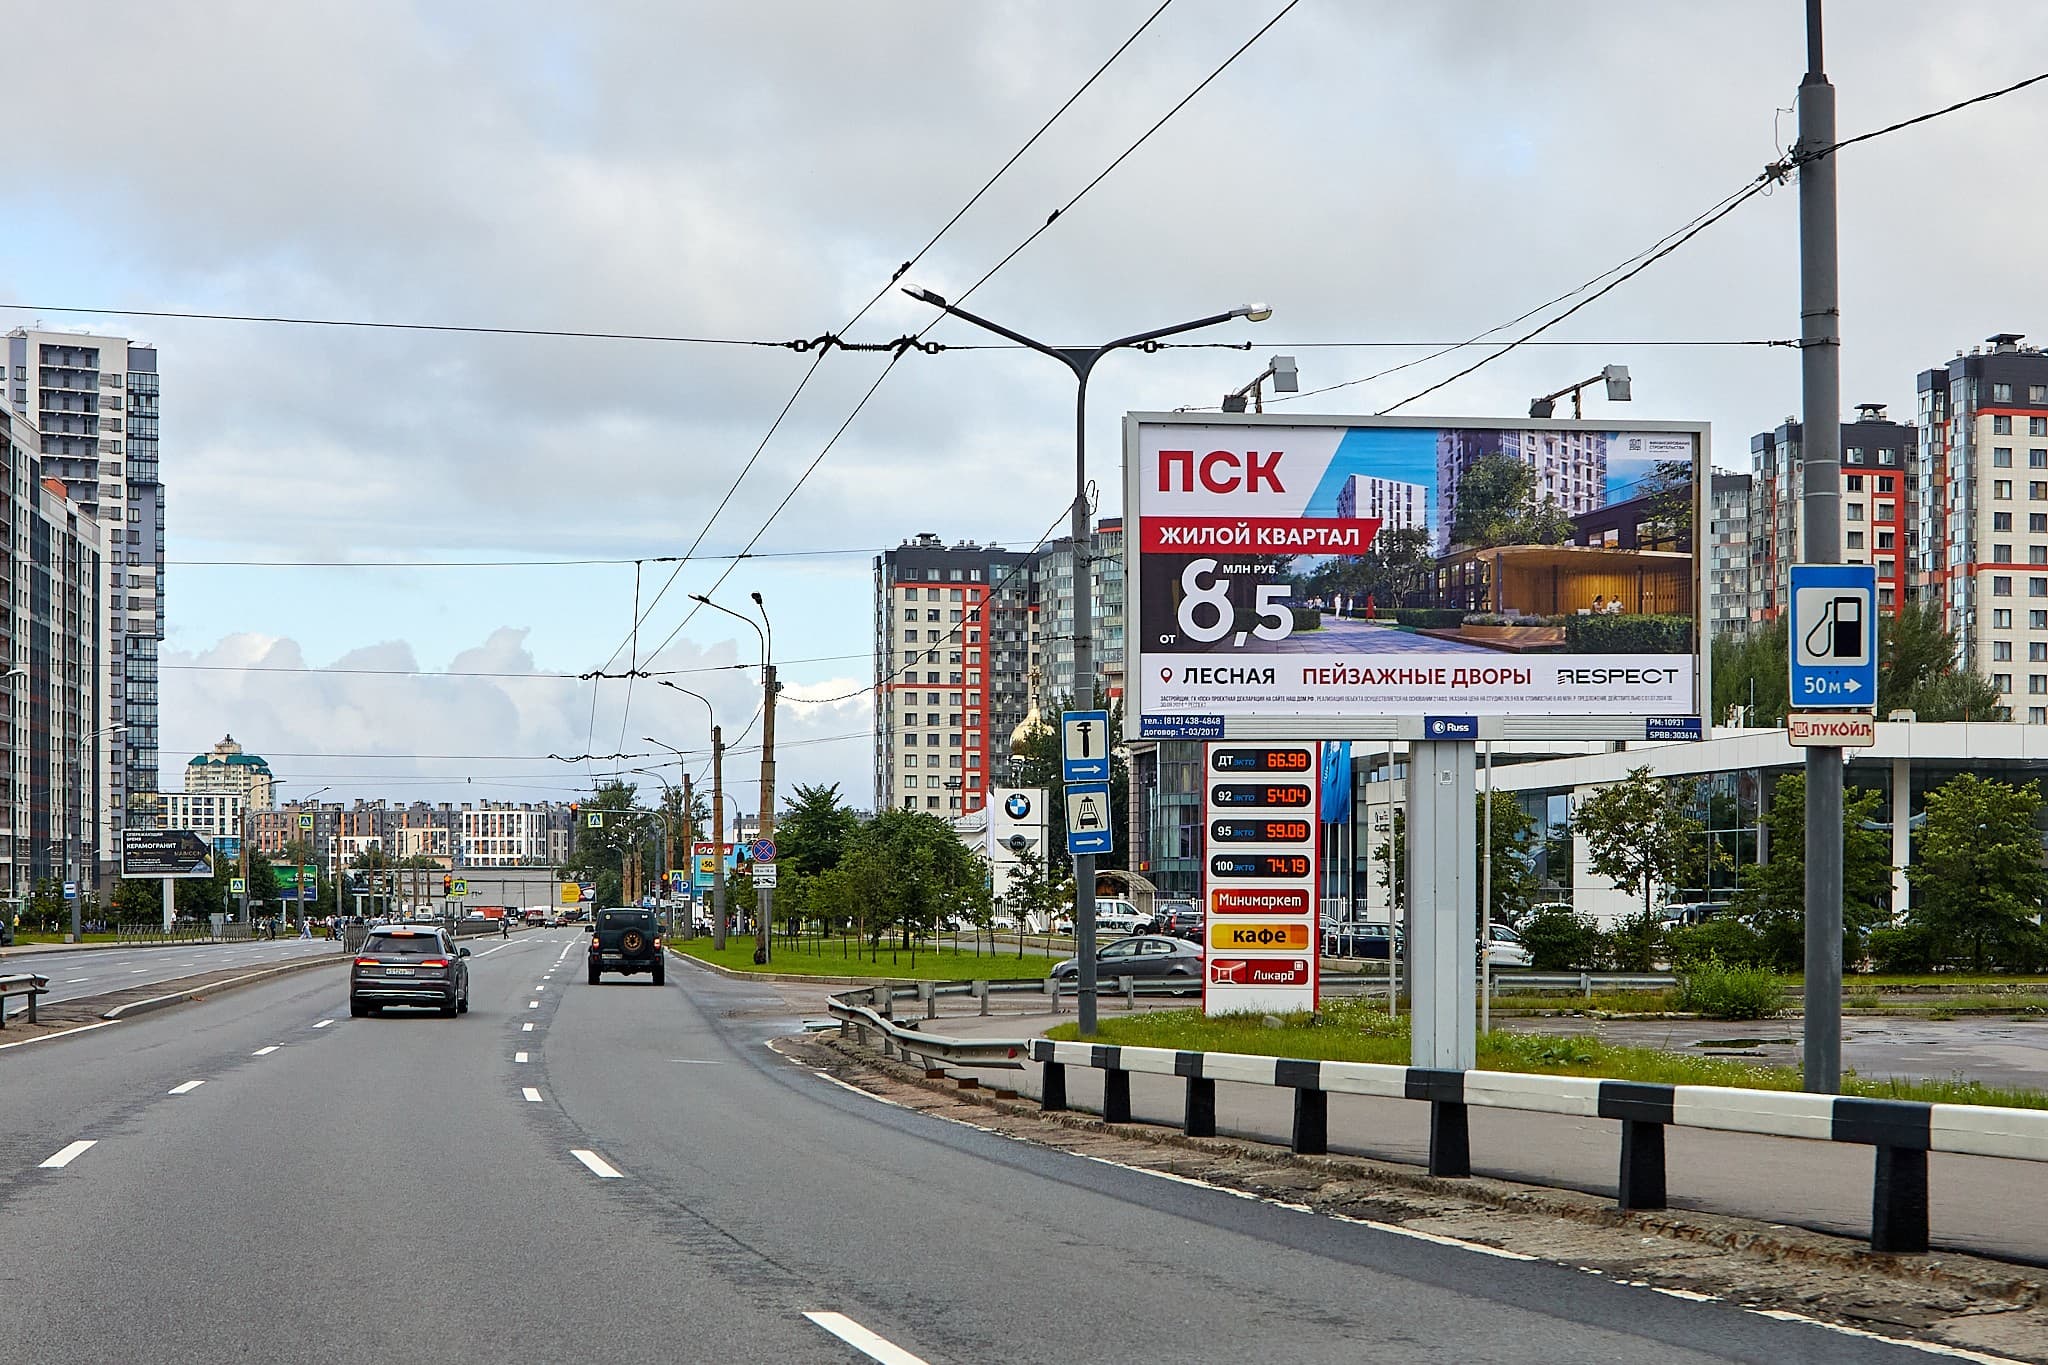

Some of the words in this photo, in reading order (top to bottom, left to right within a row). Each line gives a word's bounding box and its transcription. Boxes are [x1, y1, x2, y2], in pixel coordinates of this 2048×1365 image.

[1158, 450, 1286, 494] ПСК
[1159, 522, 1250, 545] ЖИЛОЙ
[1257, 527, 1360, 546] КВАРТАЛ
[1222, 564, 1251, 574] МЛН
[1253, 564, 1279, 574] РУБ.
[1177, 558, 1294, 647] 8,5
[1182, 667, 1276, 685] ЛЕСНАЯ
[1302, 662, 1447, 685] ПЕЙЗАЖНЫЕ
[1451, 668, 1532, 689] ДВОРЫ
[1557, 669, 1680, 685] RESPECT
[1804, 676, 1827, 694] 50
[1143, 717, 1162, 725] тел.:
[1163, 716, 1184, 725] (812)
[1185, 716, 1221, 725] 438-4848
[1446, 722, 1470, 732] Russ
[1143, 729, 1179, 737] договор:
[1810, 720, 1870, 737] ЛУКОЙЛ
[1217, 755, 1233, 767] ДТ
[1267, 753, 1307, 768] 66.98
[1218, 790, 1232, 801] 92
[1267, 788, 1306, 803] 54.04
[1217, 826, 1232, 836] 95
[1266, 823, 1306, 838] 59.08
[1215, 860, 1233, 871] 100
[1266, 858, 1305, 873] 74.19
[1218, 893, 1302, 910] Минимаркет
[1233, 928, 1287, 945] кафе
[1253, 969, 1295, 983] Ликард
